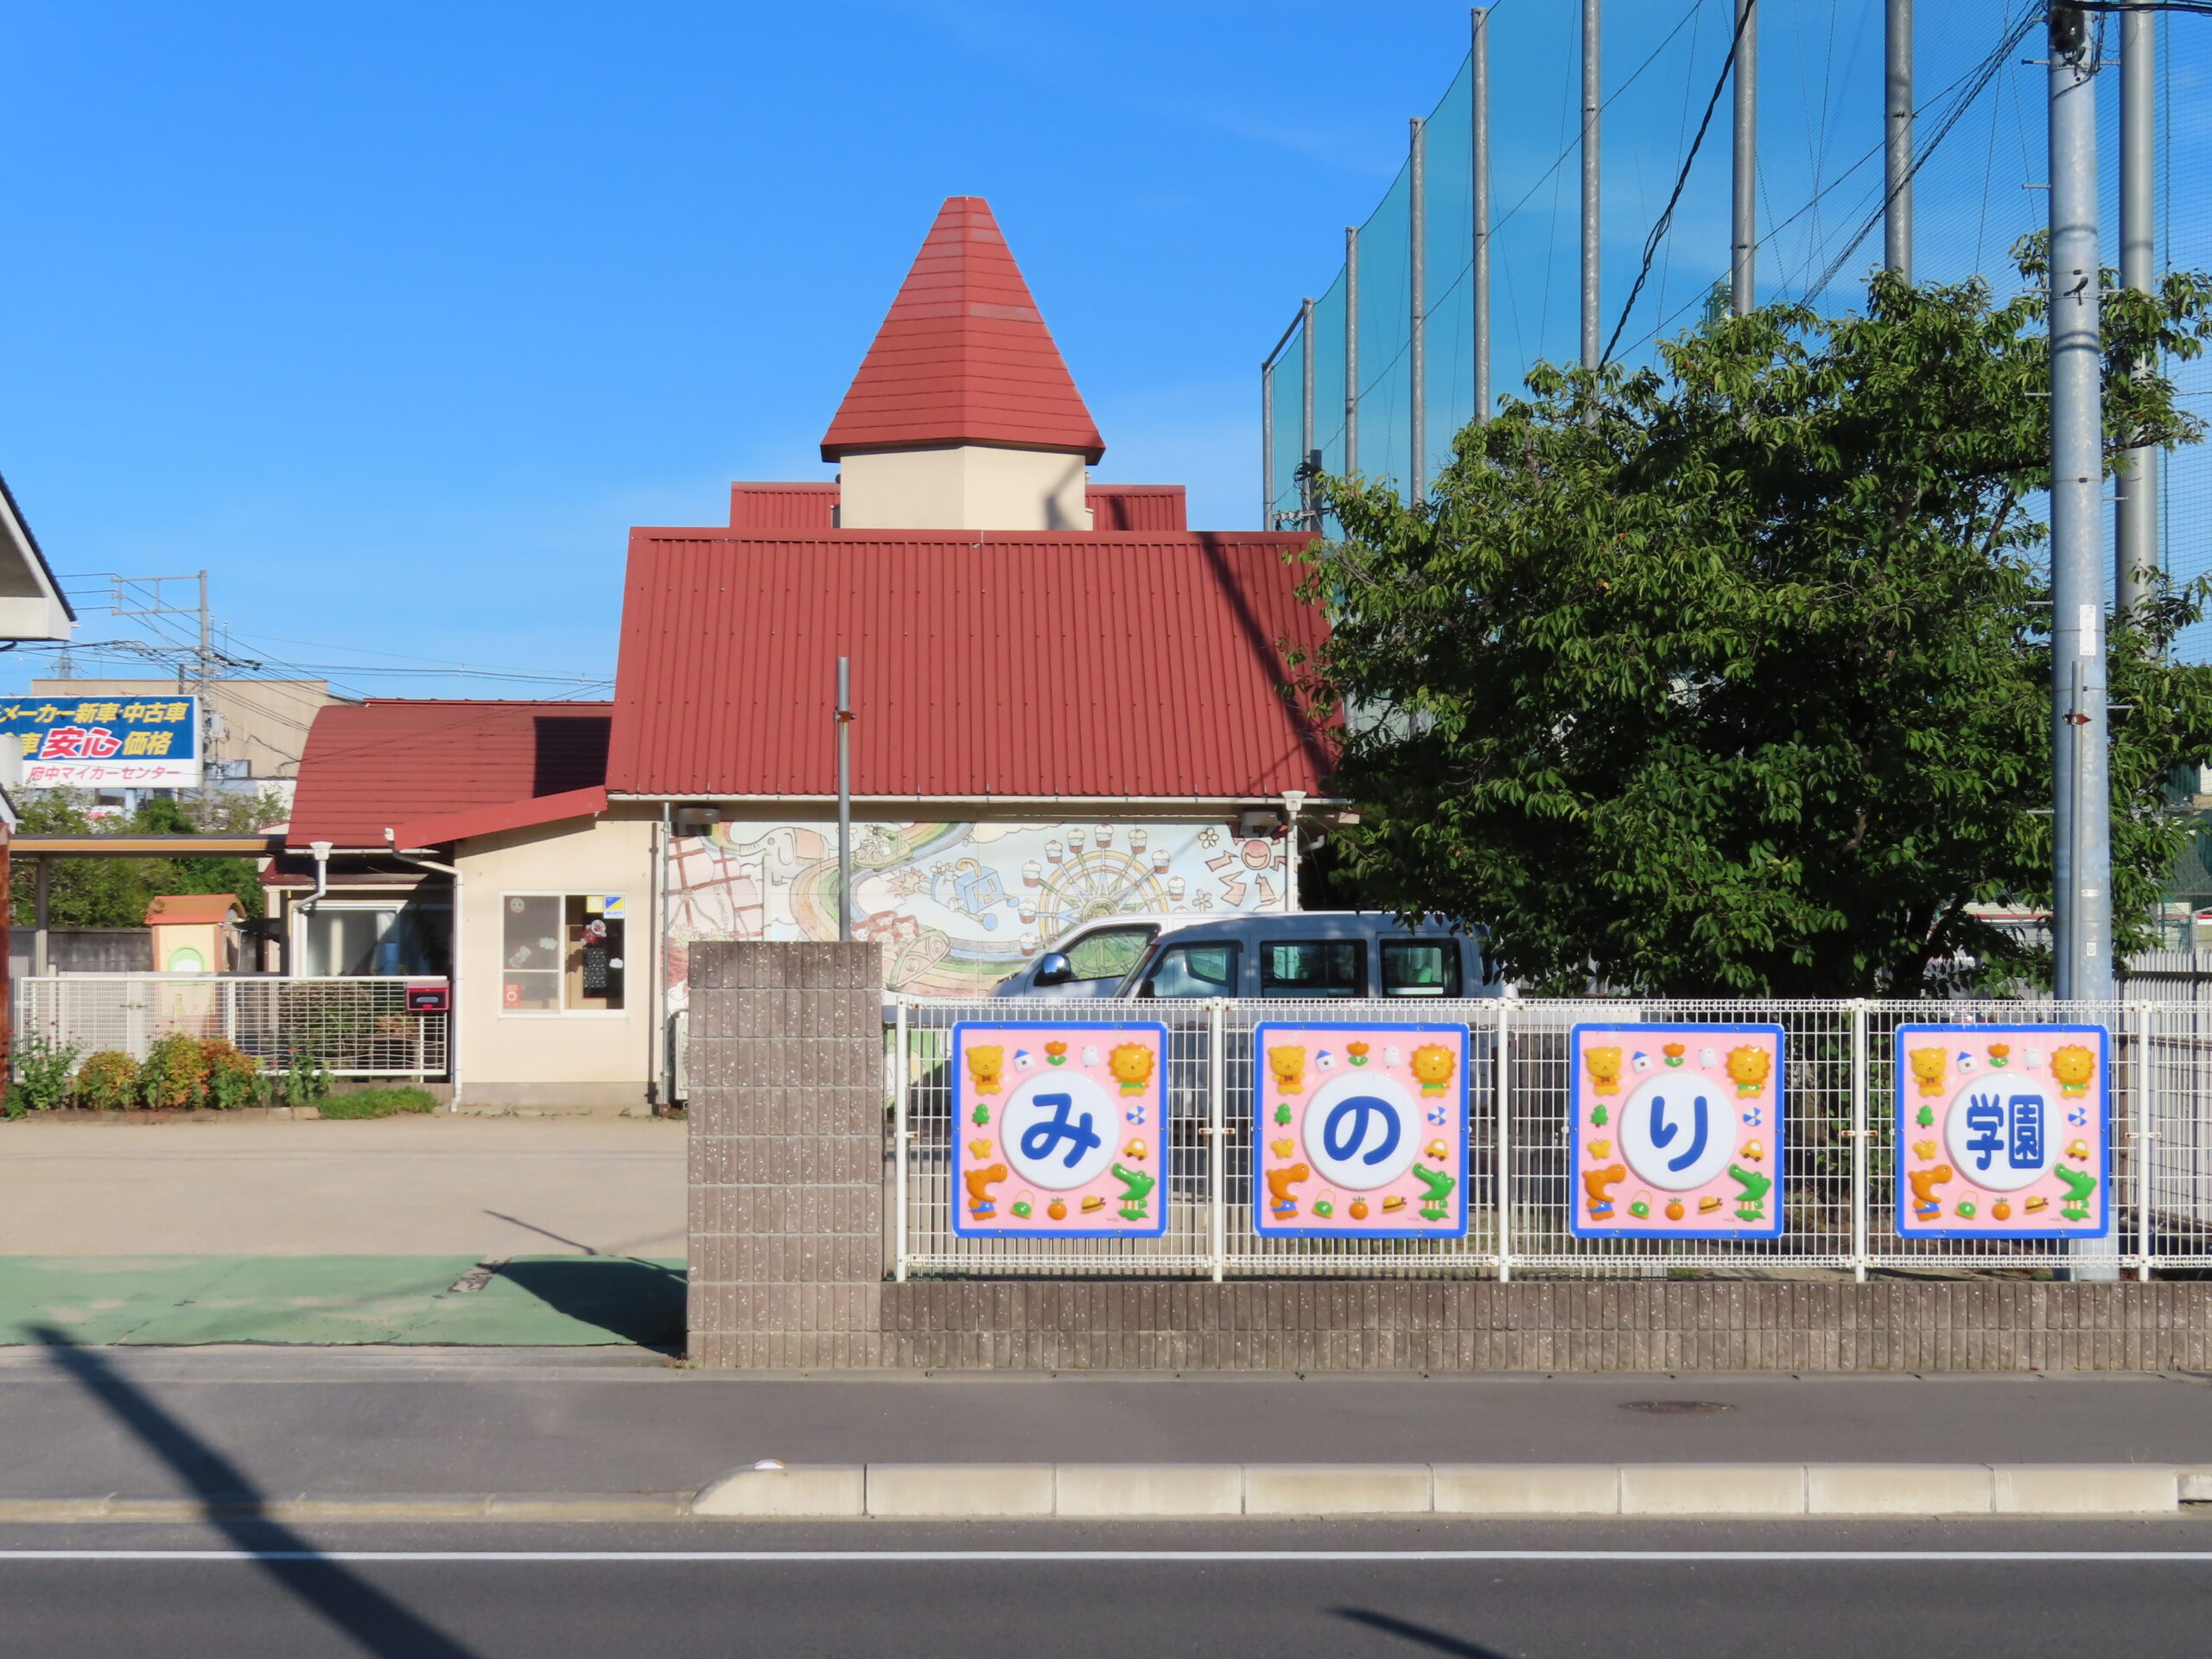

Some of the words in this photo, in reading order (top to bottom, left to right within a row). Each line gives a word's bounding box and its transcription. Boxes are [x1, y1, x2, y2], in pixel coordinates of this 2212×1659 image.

[29, 766, 181, 781] 府中マイカーセンター
[1021, 1094, 1101, 1167] み
[1324, 1096, 1400, 1165] の
[1650, 1096, 1707, 1172] り
[1967, 1095, 2044, 1170] 学園
